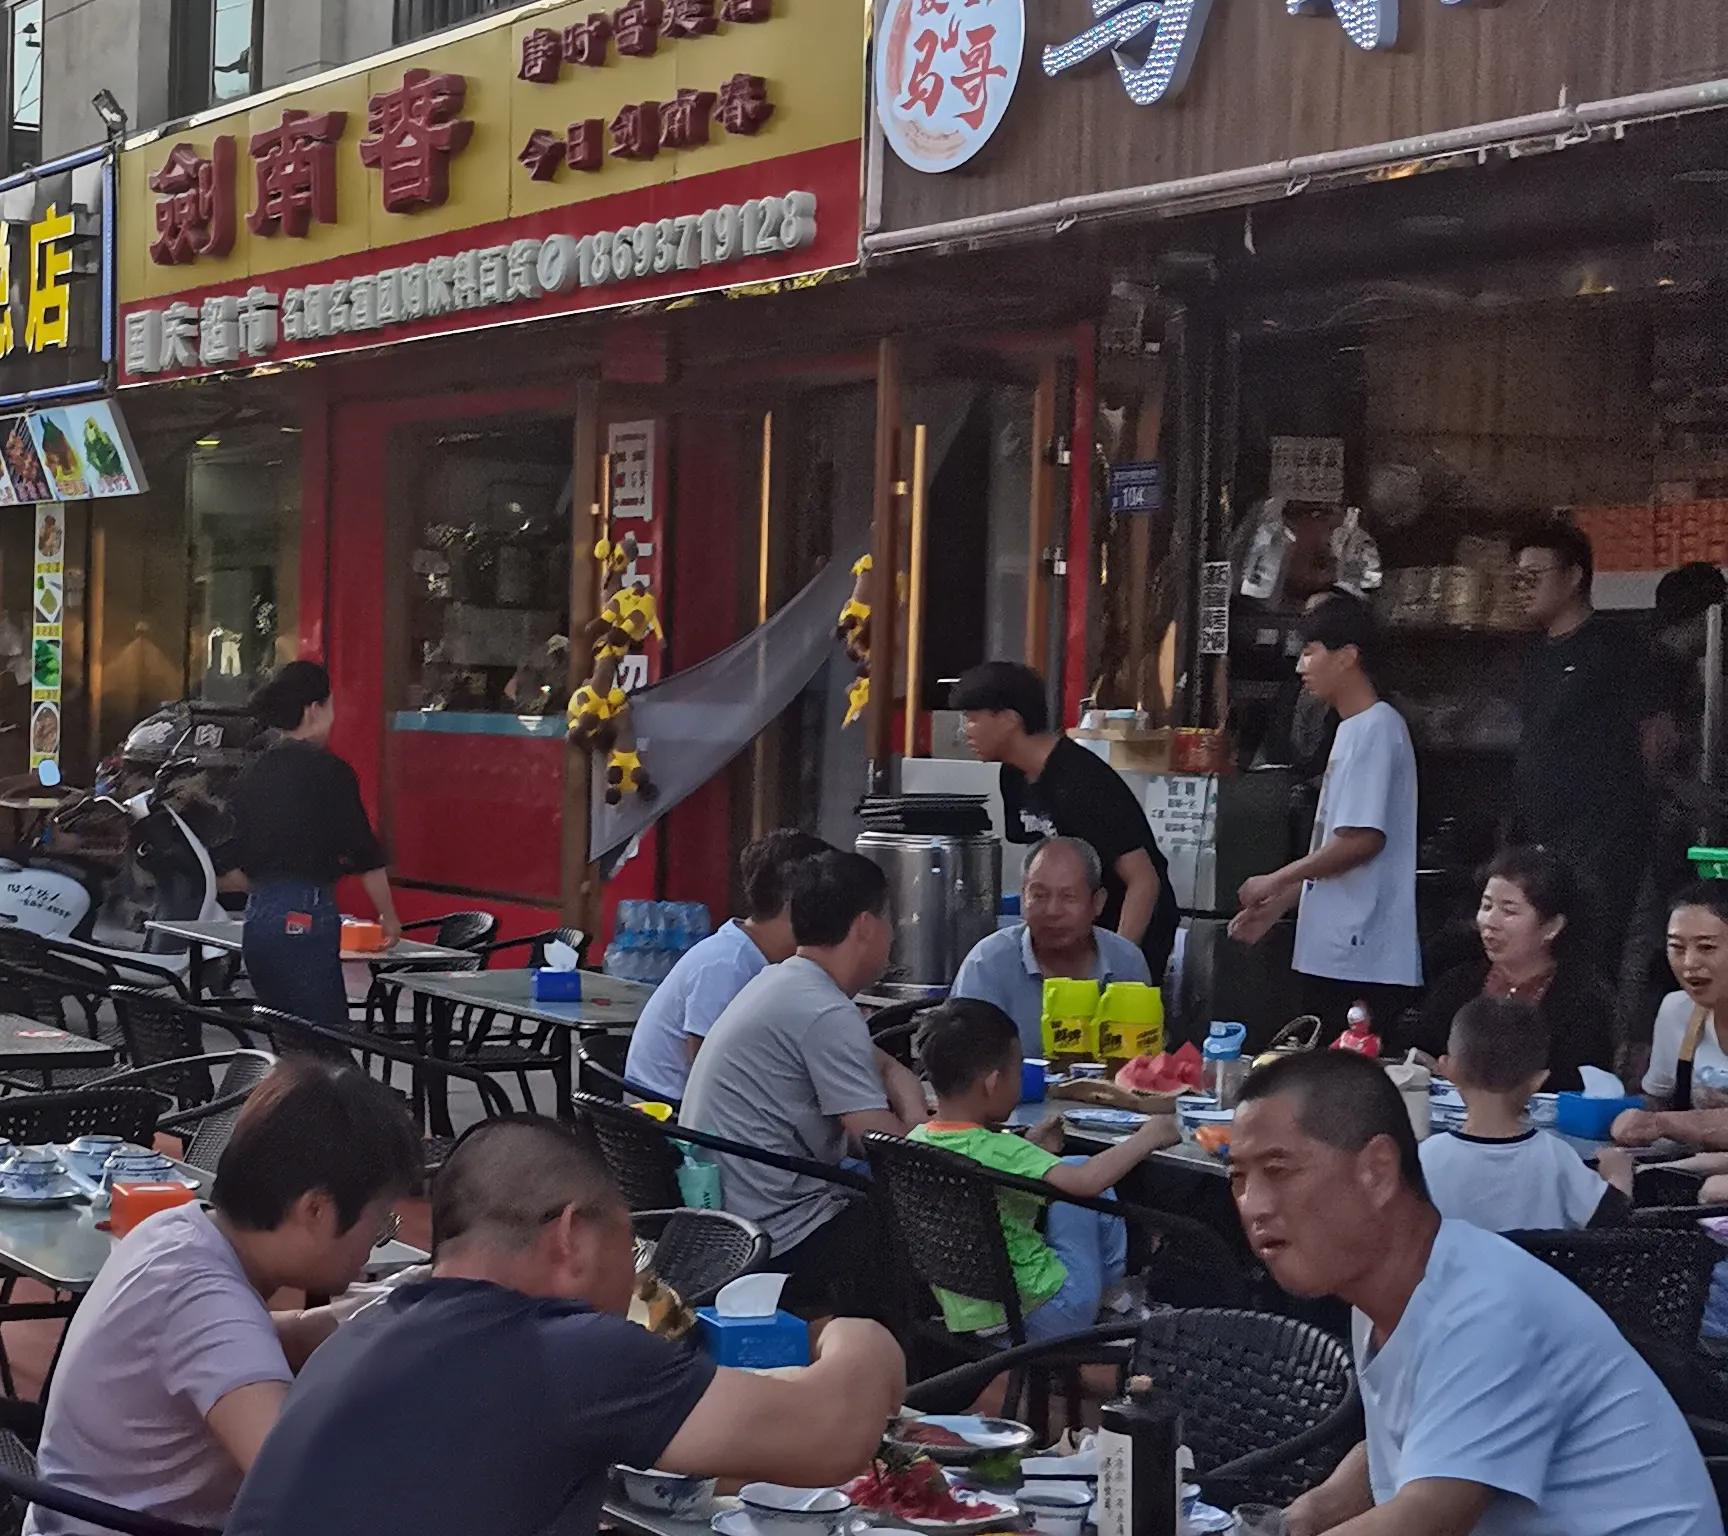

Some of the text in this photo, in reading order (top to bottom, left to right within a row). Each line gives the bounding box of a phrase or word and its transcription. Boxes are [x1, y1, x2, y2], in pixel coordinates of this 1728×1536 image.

[900, 24, 1007, 130] 马哥
[576, 190, 817, 287] 18693719128
[124, 286, 279, 376] 国庆超市
